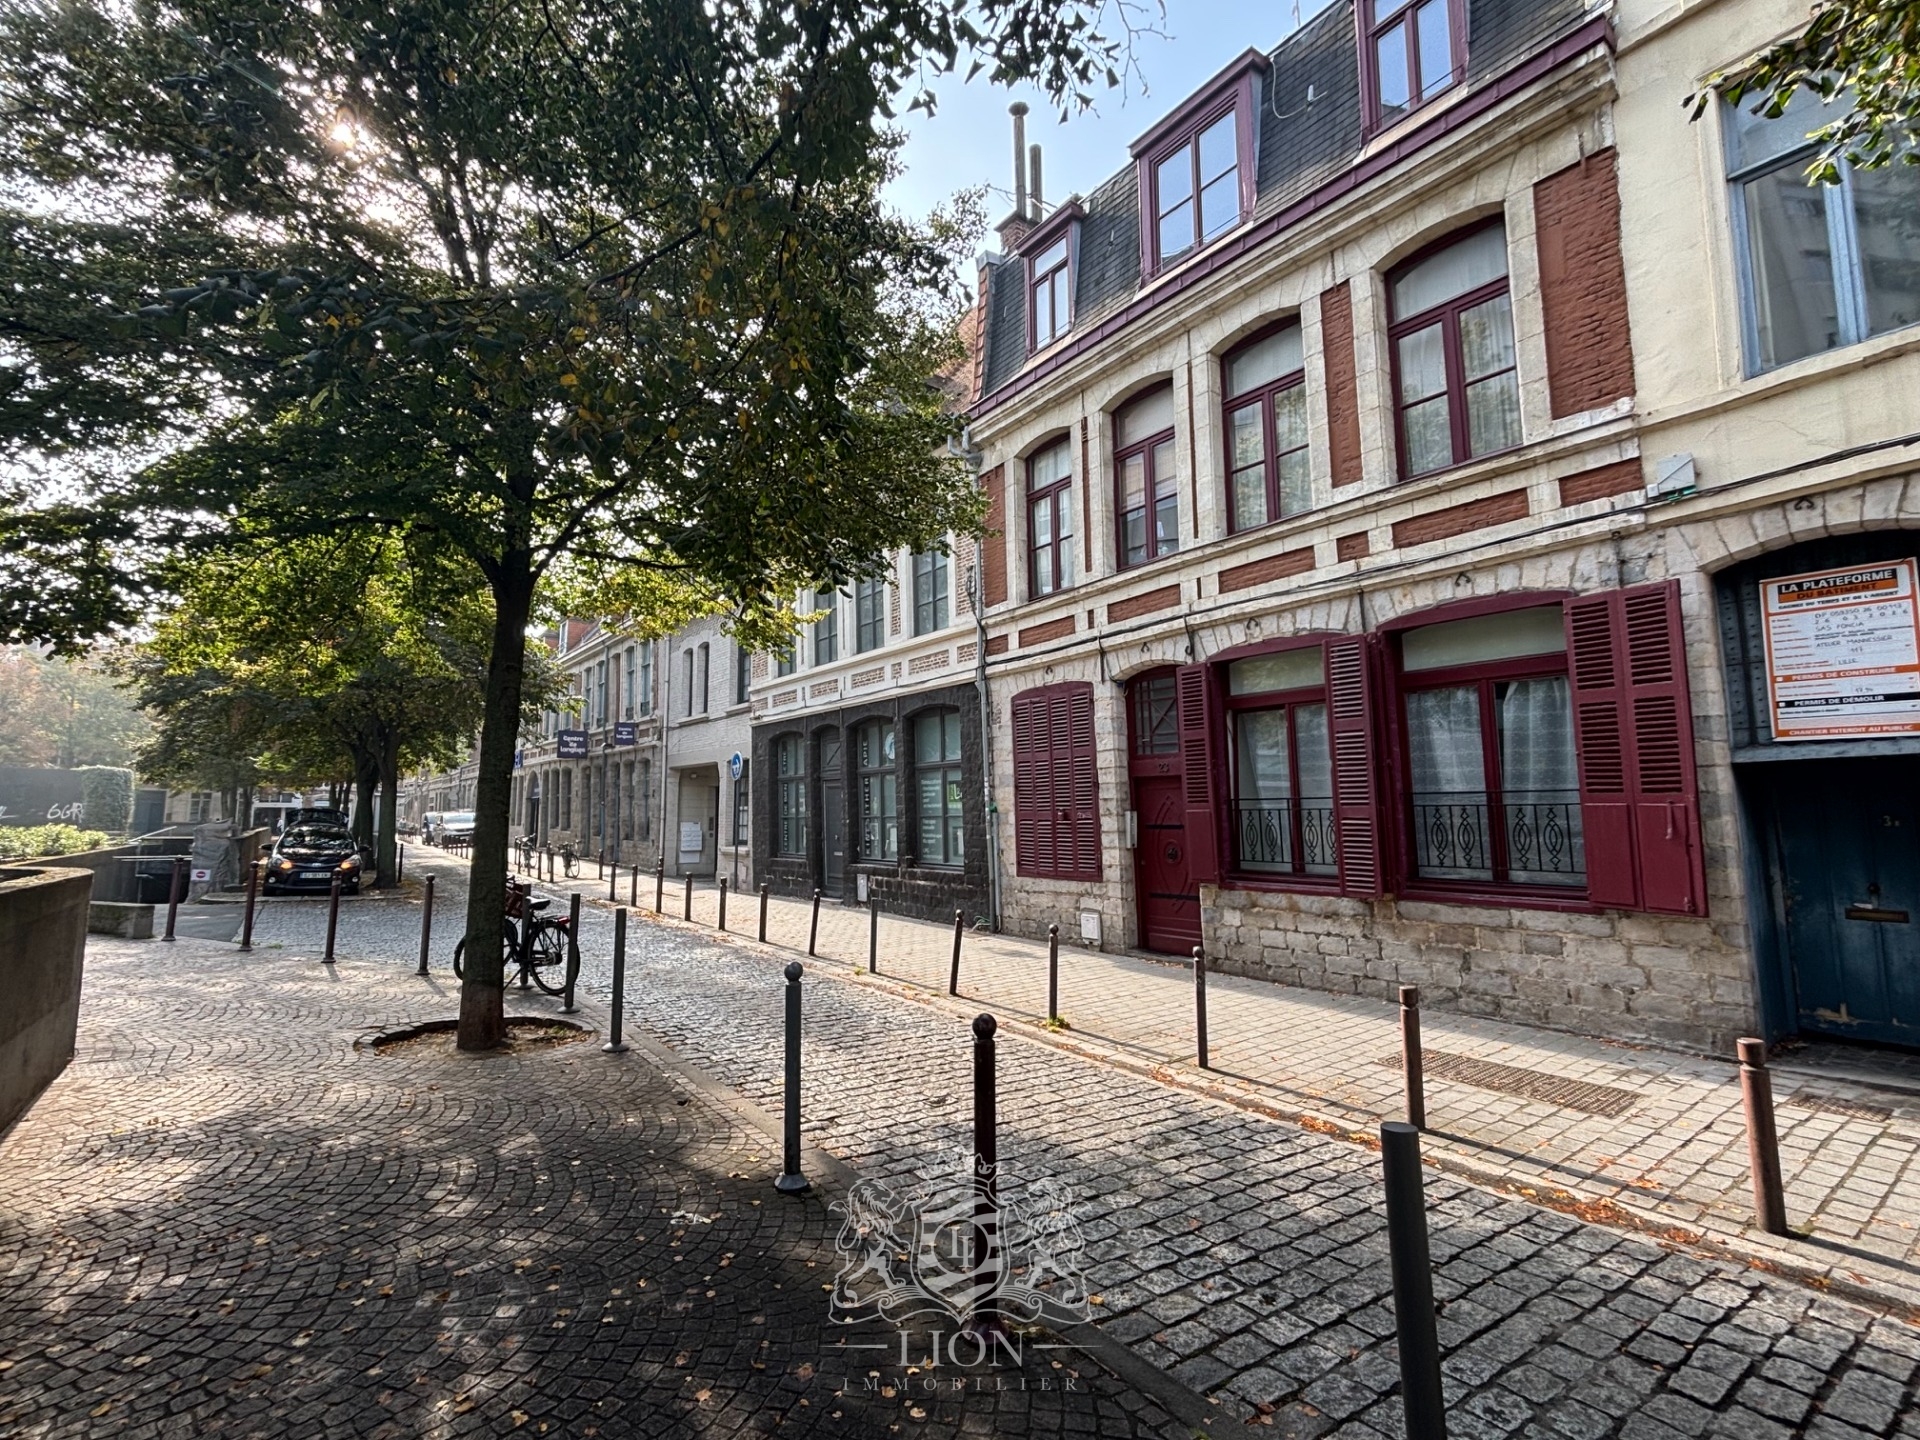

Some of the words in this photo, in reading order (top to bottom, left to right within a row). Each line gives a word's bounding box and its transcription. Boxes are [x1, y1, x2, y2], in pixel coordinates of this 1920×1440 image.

[1781, 583, 1799, 594] LA
[1803, 569, 1893, 591] PLATEFORME
[1797, 592, 1813, 600] DU
[1817, 598, 1840, 606] TEMPS
[1815, 640, 1842, 648] ATELIER
[1791, 672, 1825, 681] PERMIS
[1840, 667, 1897, 677] CONSTRUIRE
[1794, 699, 1827, 707] PERMIS
[1789, 728, 1828, 736] CHANTIER
[1829, 726, 1866, 734] INTERDIT
[1882, 724, 1913, 732] PUBLIC
